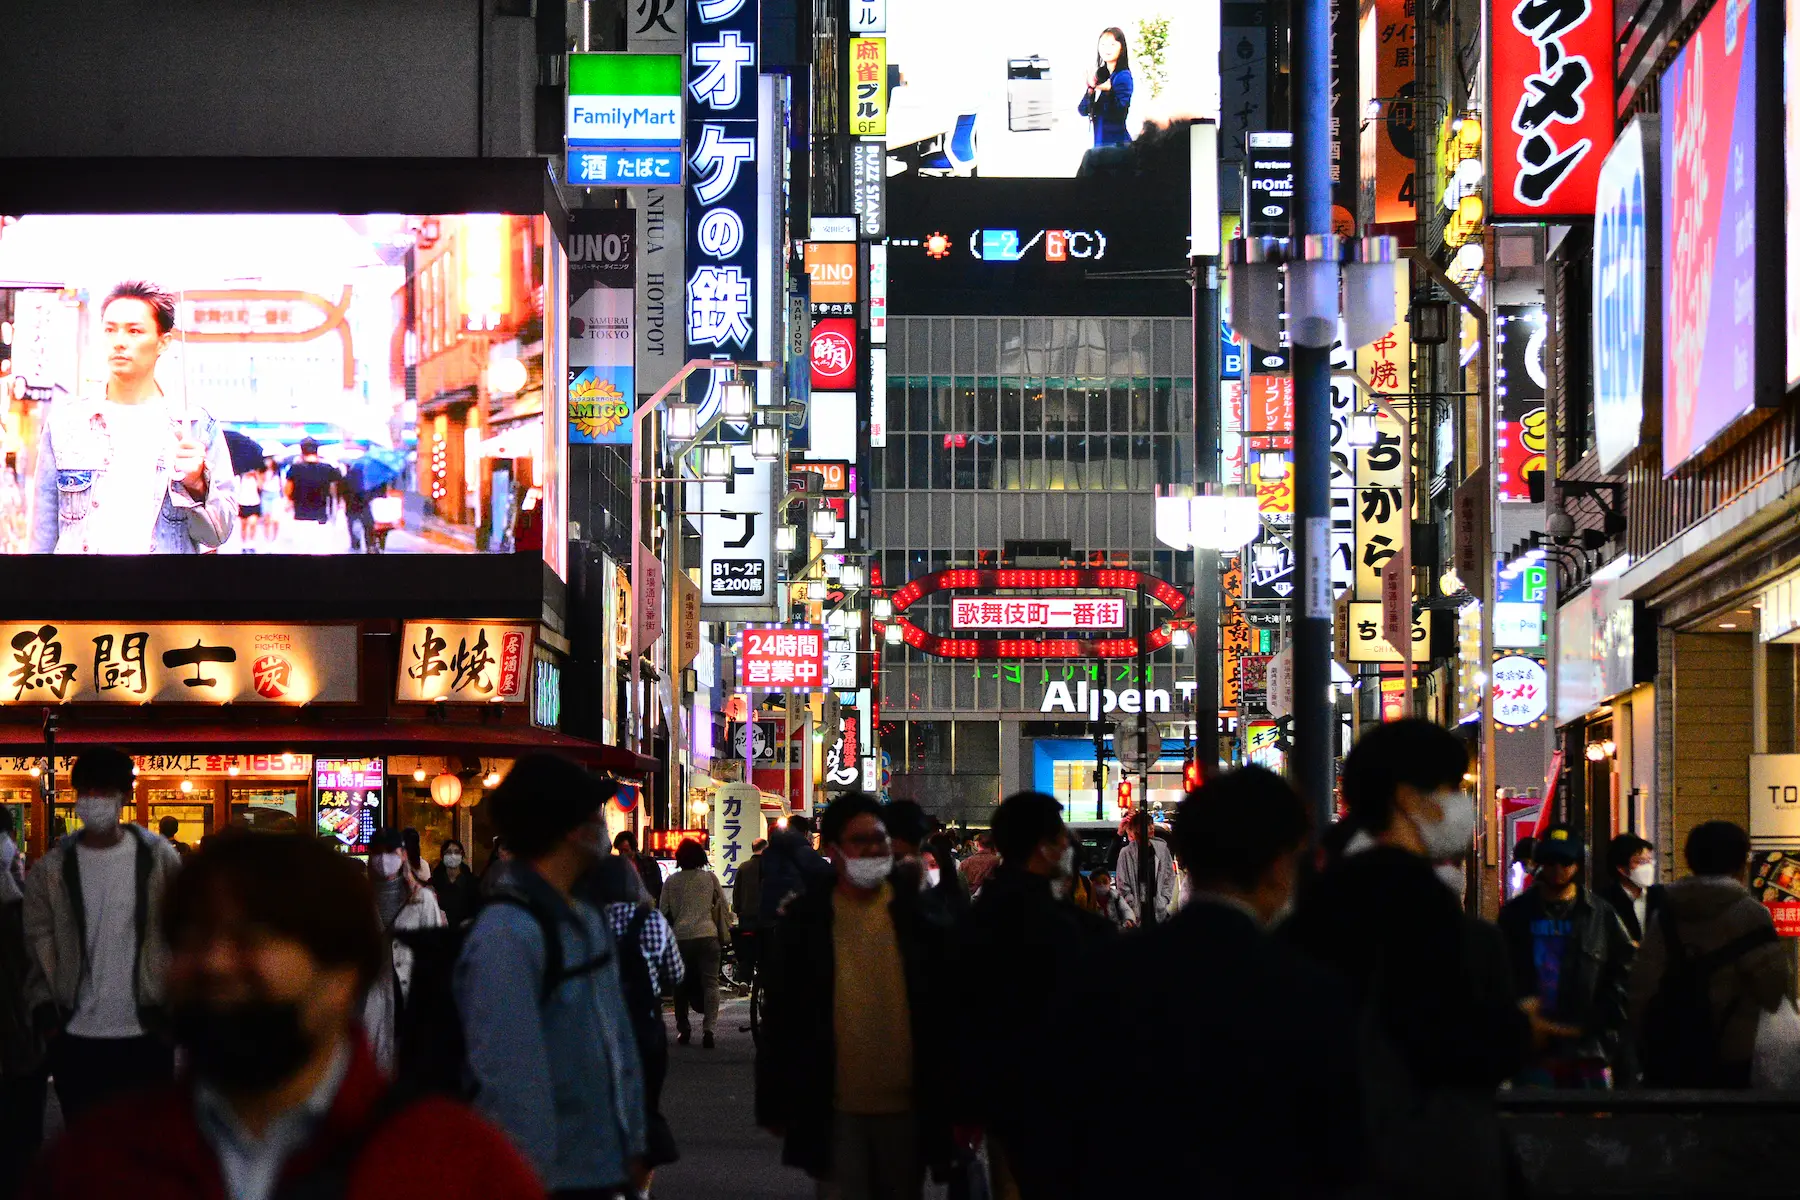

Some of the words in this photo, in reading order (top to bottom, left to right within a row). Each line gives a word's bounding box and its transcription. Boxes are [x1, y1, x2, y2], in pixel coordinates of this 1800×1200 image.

[856, 41, 879, 118] 麻雀ブル
[573, 107, 676, 129] FamilyMart
[858, 121, 876, 133] 6F
[581, 154, 607, 180] 酒
[617, 157, 671, 179] たばこ
[854, 146, 863, 175] DARTS
[865, 145, 880, 182] BUZZ
[865, 184, 880, 235] STAND
[569, 234, 622, 262] UNO
[809, 264, 853, 281] ZINO
[588, 317, 629, 325] SAMURAI
[647, 272, 665, 356] HOTPOT
[588, 331, 630, 340] TOKYO
[568, 403, 629, 420] AMIGO
[712, 579, 762, 592] 全200席
[957, 602, 1119, 626] 歌舞伎町一番街
[255, 634, 290, 642] CHICKEN
[255, 643, 292, 651] FIGHTER
[748, 634, 818, 657] 24時間
[408, 626, 496, 697] 串焼
[501, 636, 519, 692] 居酒屋
[747, 660, 818, 683] 営業中
[1040, 681, 1170, 721] Alpen
[723, 796, 742, 886] カラオケ
